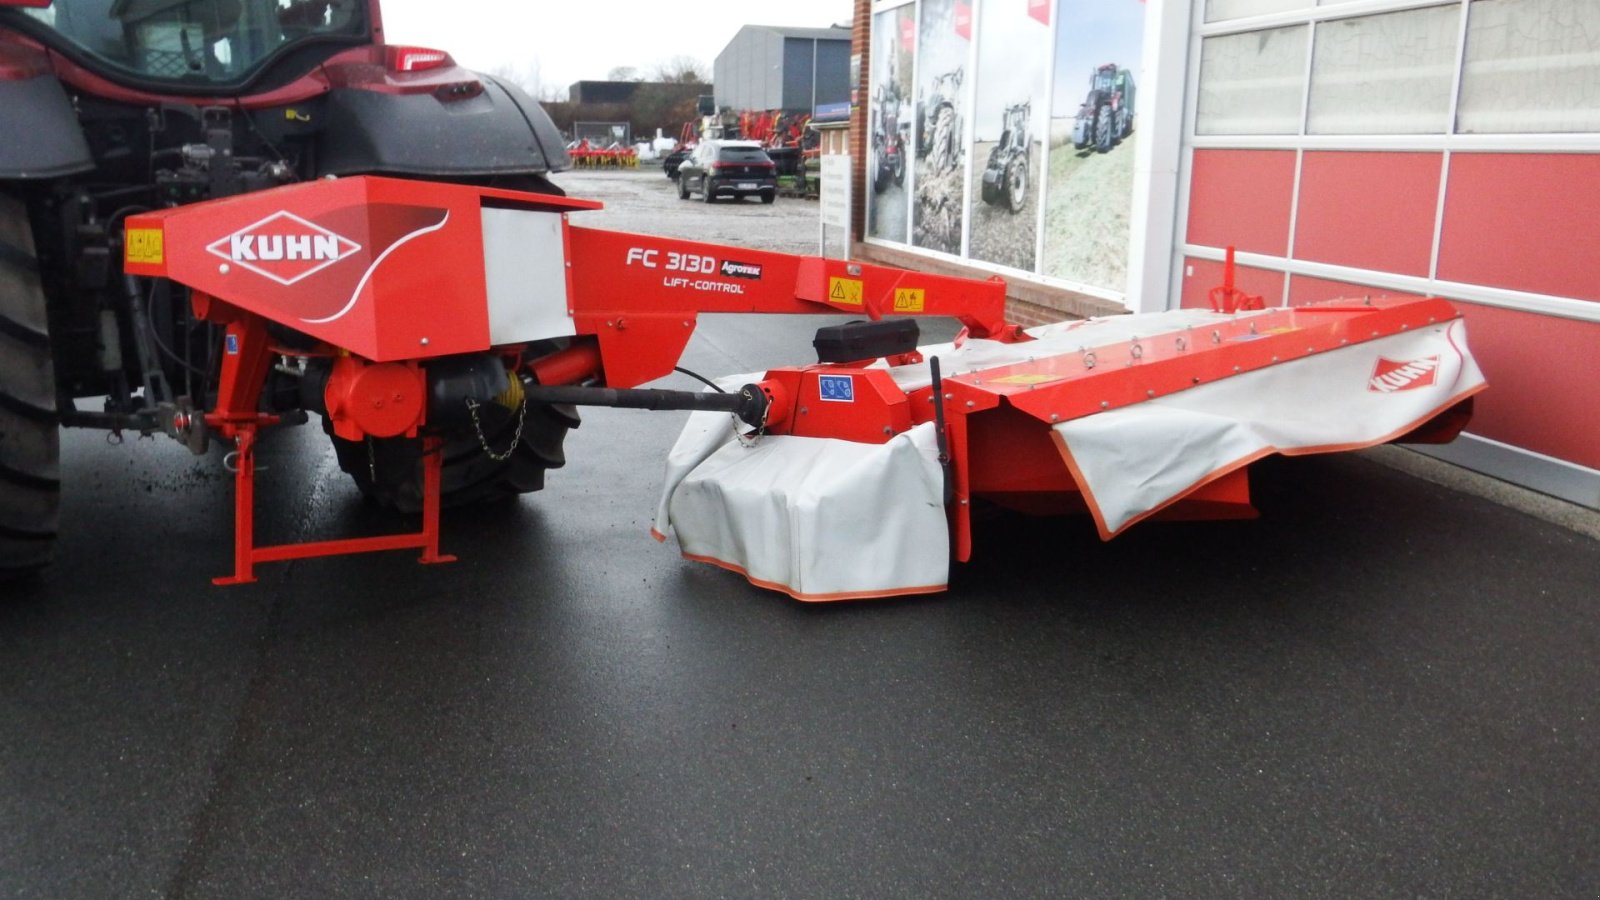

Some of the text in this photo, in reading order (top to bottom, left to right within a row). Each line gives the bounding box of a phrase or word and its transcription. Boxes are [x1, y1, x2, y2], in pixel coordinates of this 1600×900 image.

[231, 234, 339, 261] KUHN
[626, 247, 715, 274] FC 313D
[663, 277, 743, 294] LIFT-CONTROL
[1370, 357, 1439, 393] KUHN
